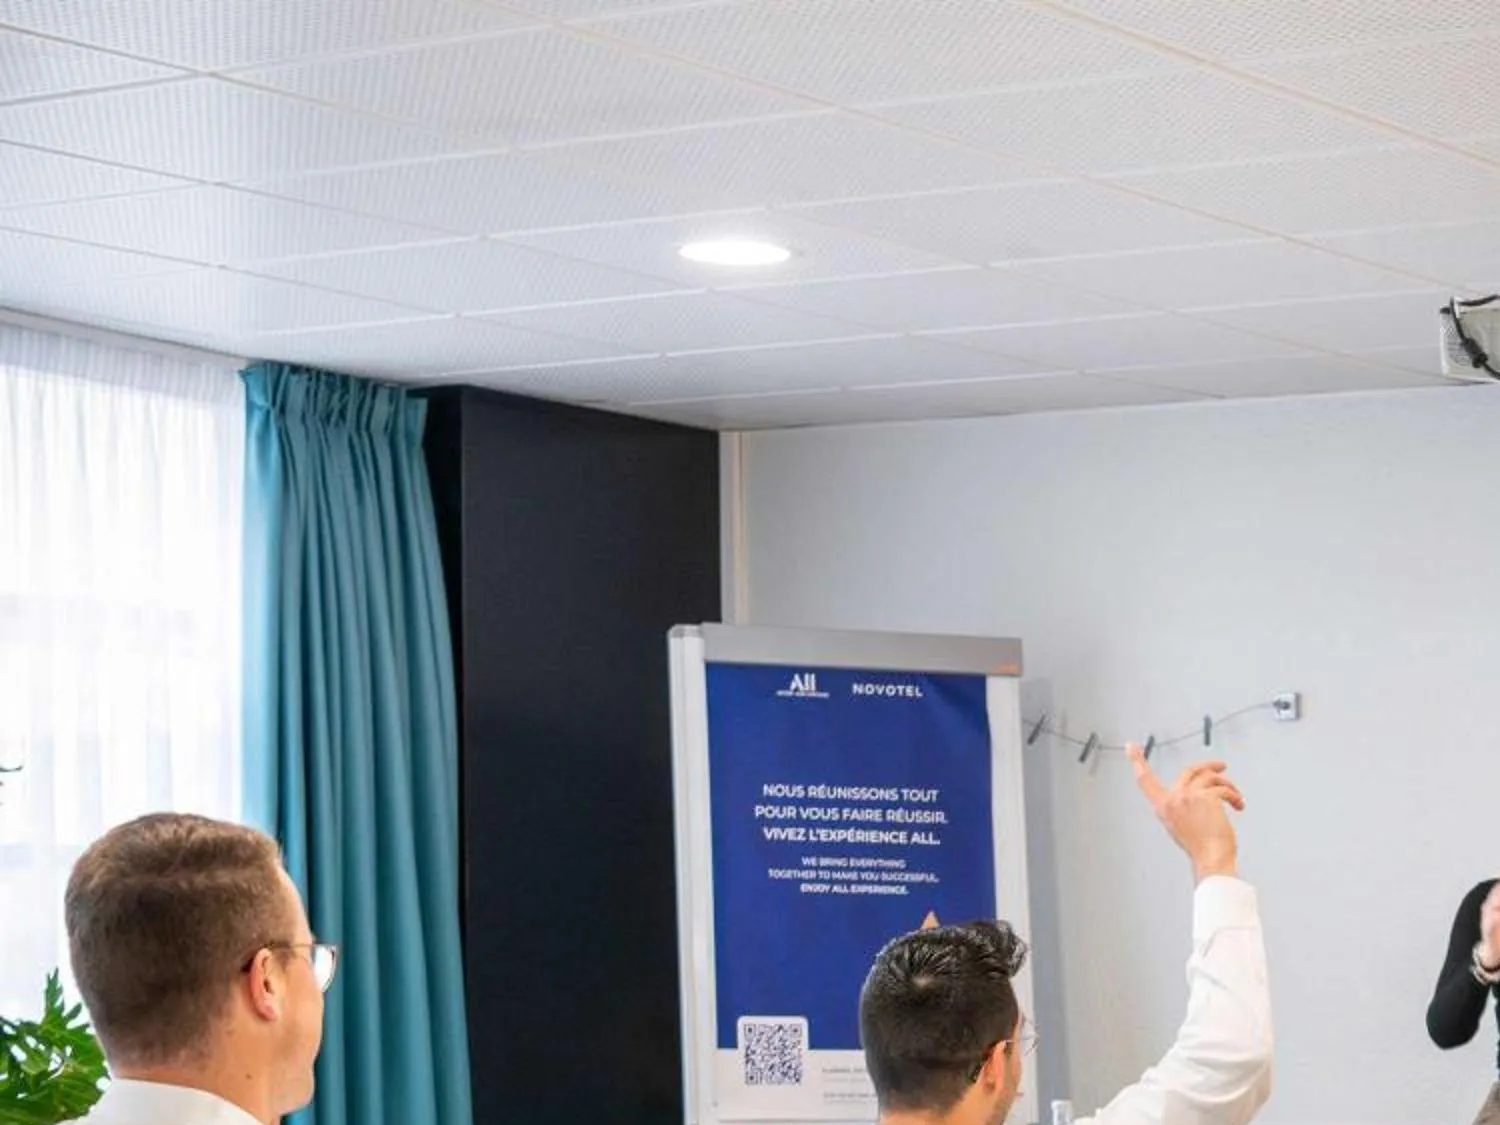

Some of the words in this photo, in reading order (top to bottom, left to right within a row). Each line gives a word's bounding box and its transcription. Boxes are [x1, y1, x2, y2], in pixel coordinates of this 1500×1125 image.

[853, 683, 923, 697] NOVOTEL
[763, 784, 805, 798] NOUS
[808, 784, 898, 800] RÉUNISSONS
[902, 789, 939, 802] TOUT
[755, 805, 797, 818] POUR
[799, 807, 840, 820] VOUS
[842, 809, 883, 822] FAIRE
[886, 809, 948, 824] RÉUSSIR.
[763, 828, 806, 841] VIVEZ
[910, 832, 940, 845] ALL.
[801, 857, 817, 867] WE
[819, 857, 848, 867] BRING
[850, 858, 906, 868] EVERYTHING
[768, 868, 817, 879] TOGETHER
[818, 869, 831, 879] TO
[832, 870, 858, 881] MAKE
[859, 871, 879, 881] YOU
[800, 883, 831, 893] ENJOY
[832, 884, 849, 893] ALL
